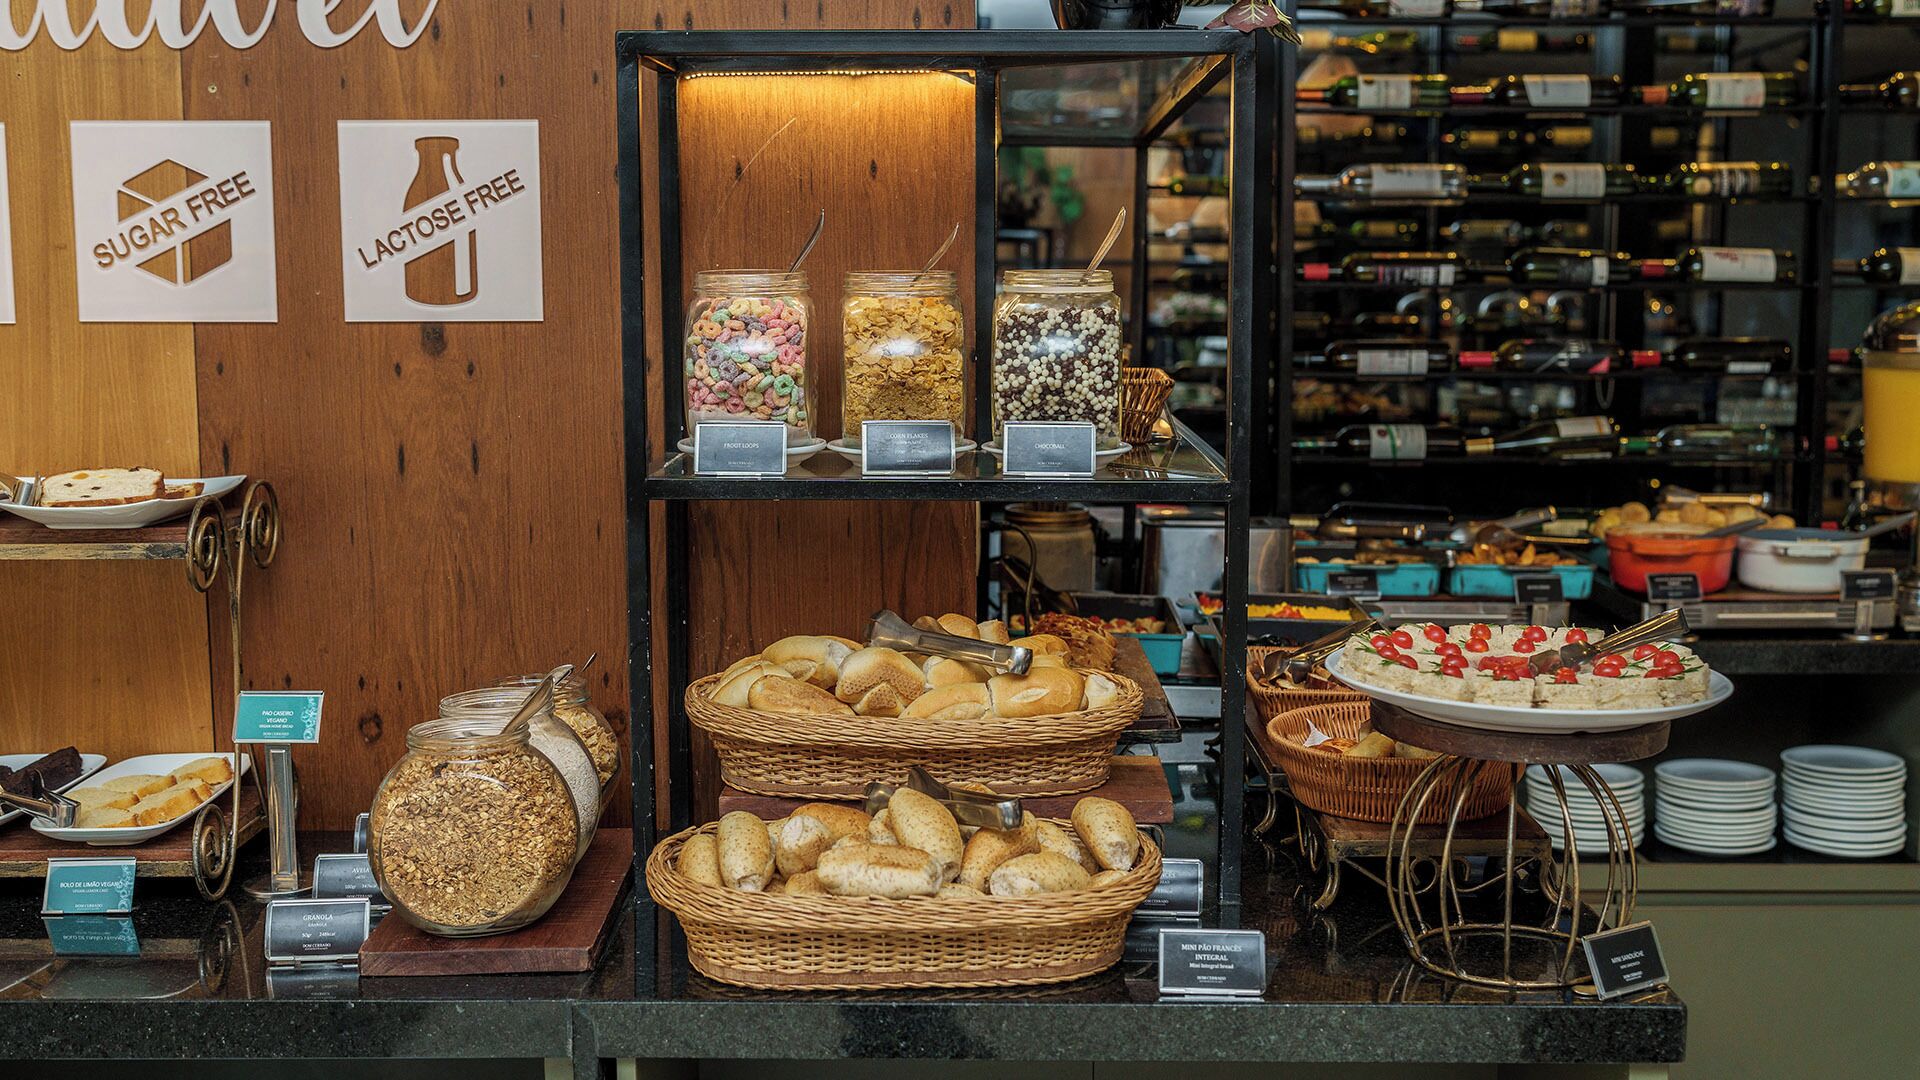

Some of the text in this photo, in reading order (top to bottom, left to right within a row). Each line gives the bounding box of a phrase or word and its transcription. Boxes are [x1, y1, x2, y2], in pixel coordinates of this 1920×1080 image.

[92, 170, 256, 270] SUGAR FREE
[356, 168, 525, 270] LACTOSE FREE
[82, 880, 100, 888] LIMÃO
[302, 913, 334, 921] GRANOLA
[1181, 943, 1242, 952] MINI PÃO FRANCÊS
[1195, 953, 1229, 961] INTEGRAL
